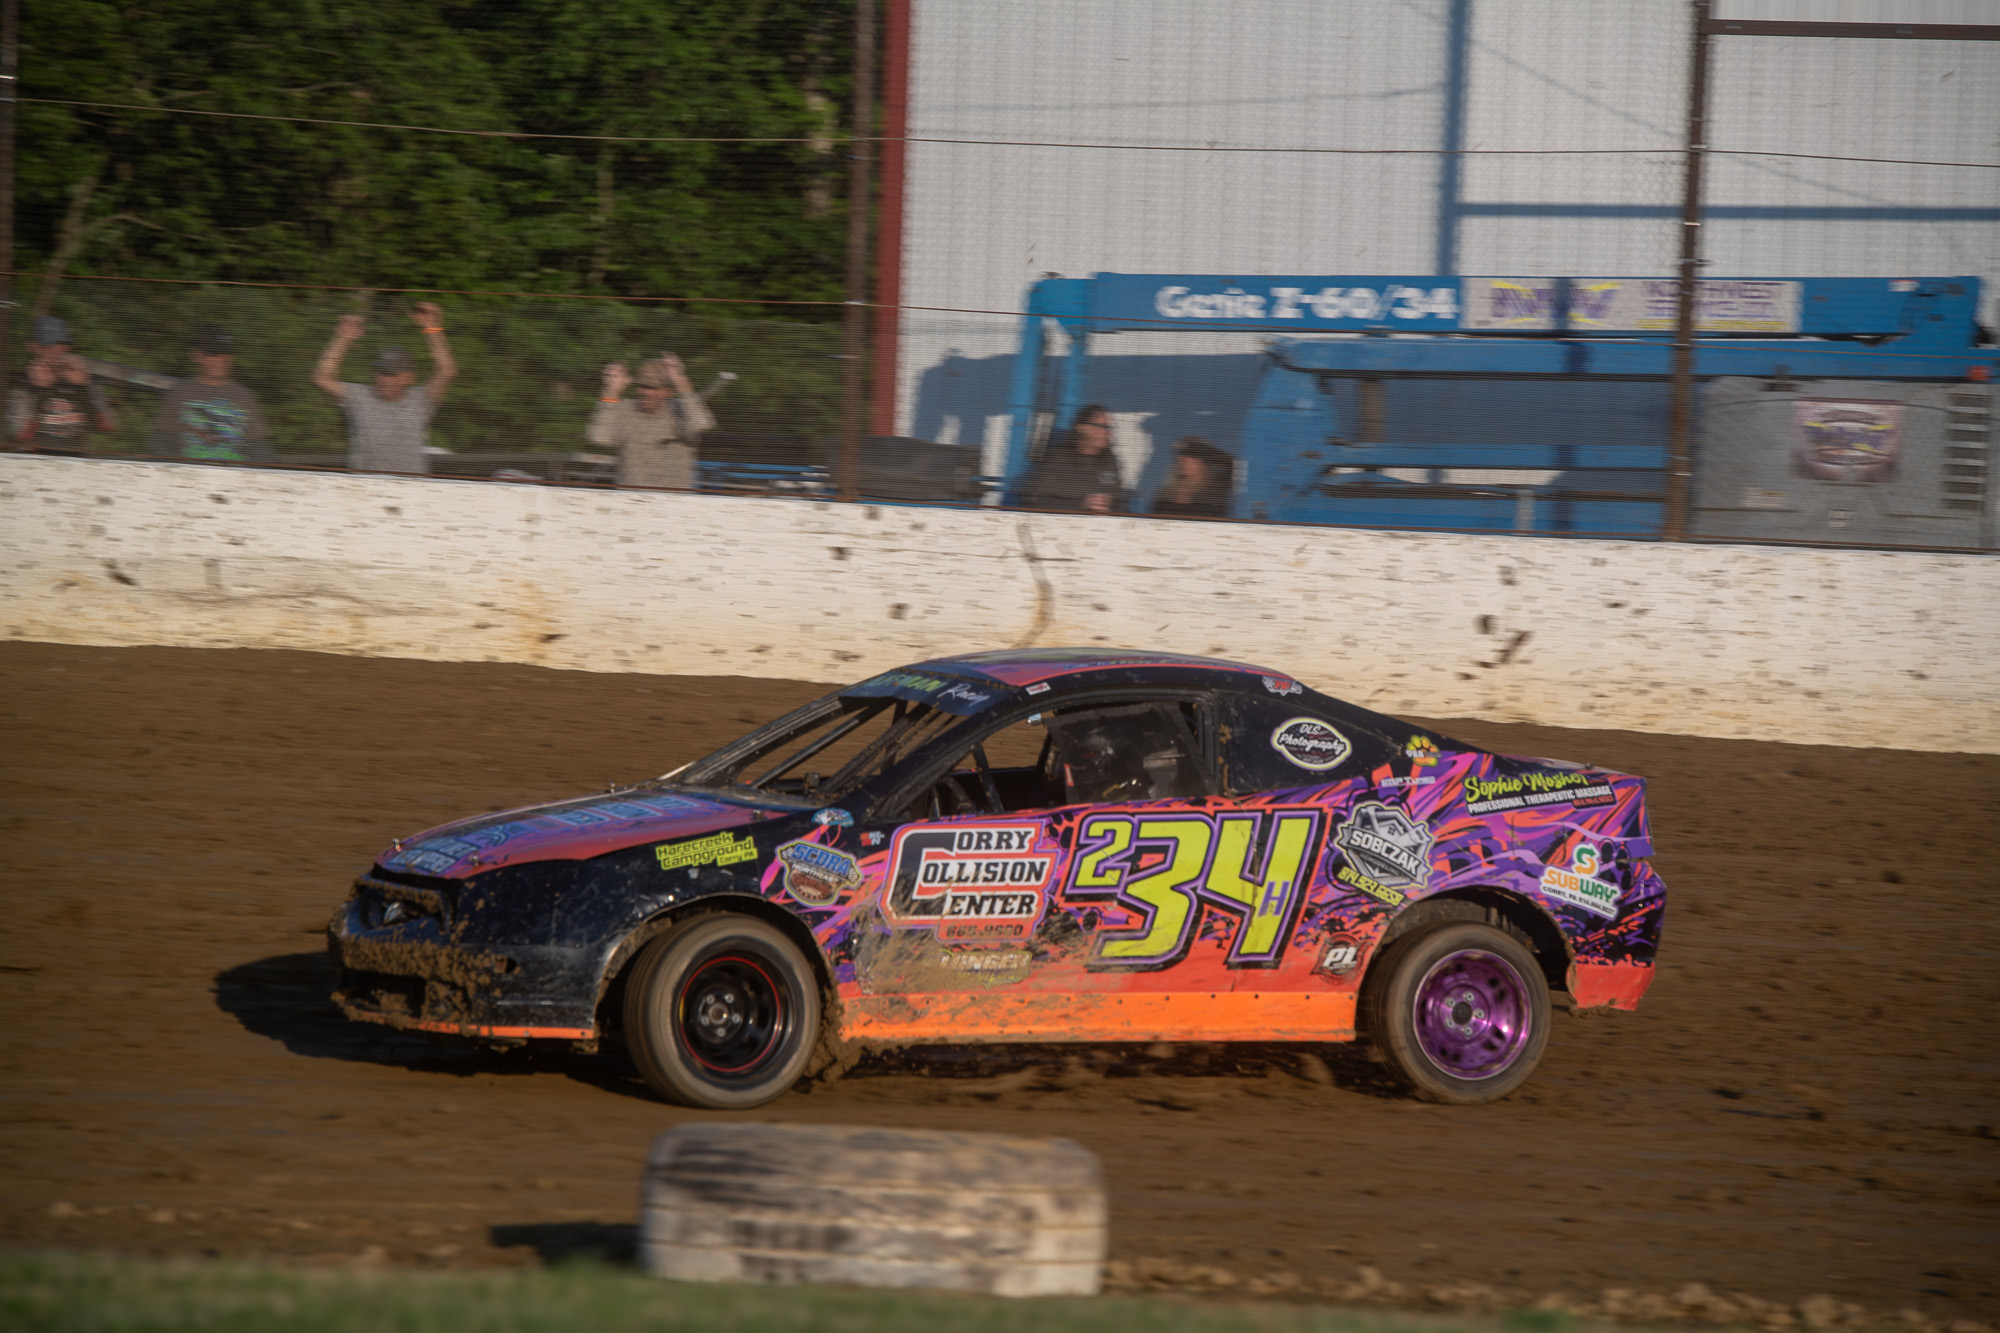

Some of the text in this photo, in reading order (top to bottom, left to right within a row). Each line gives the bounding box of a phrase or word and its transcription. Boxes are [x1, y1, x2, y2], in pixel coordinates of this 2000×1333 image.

[1154, 286, 1266, 319] Genie
[1280, 733, 1345, 755] Photography
[1300, 724, 1321, 735] DLS
[1464, 772, 1589, 802] Sophie Mosher
[1467, 796, 1526, 814] PROFESSIONAL
[1524, 790, 1576, 805] THERAPEUTIC
[1575, 785, 1613, 798] MASSAGE
[657, 833, 734, 856] Harecreek
[663, 840, 752, 868] Campground
[1349, 830, 1420, 875] SOBCZAK
[1543, 869, 1618, 903] SUBWAY
